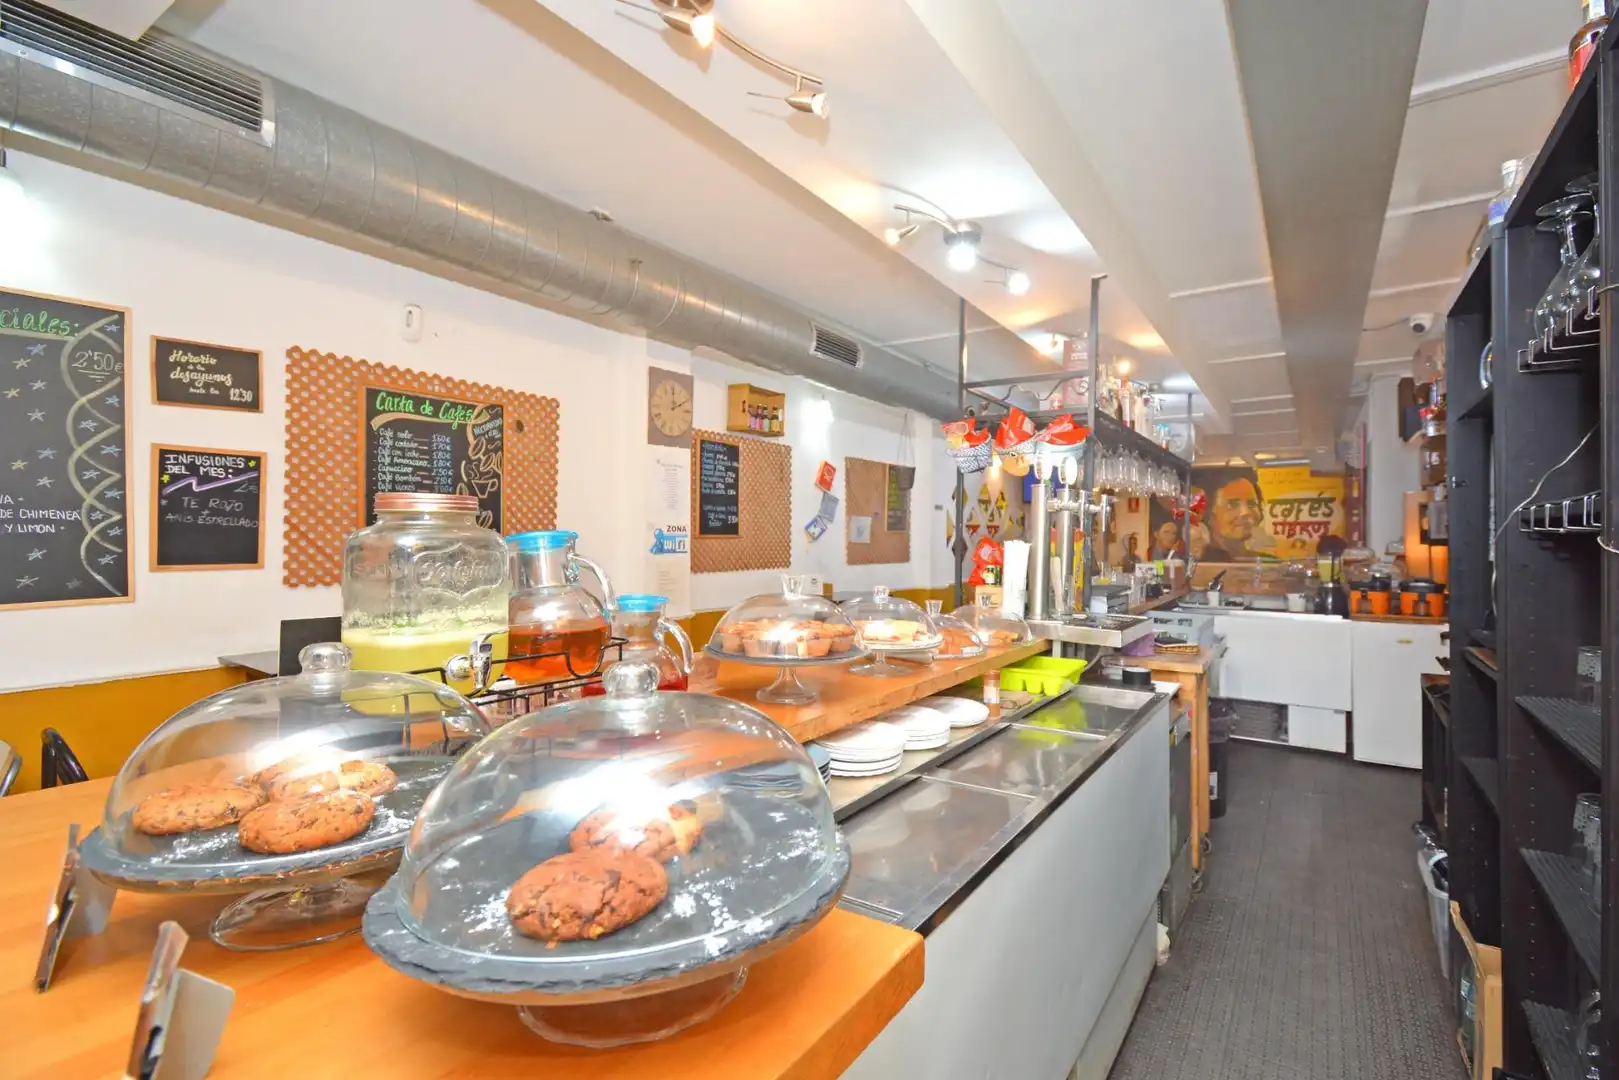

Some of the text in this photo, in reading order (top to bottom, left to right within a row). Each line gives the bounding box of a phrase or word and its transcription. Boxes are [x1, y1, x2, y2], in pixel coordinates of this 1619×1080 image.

[168, 349, 217, 365] Horario
[169, 366, 233, 387] desayunos
[375, 391, 415, 412] Carta
[419, 399, 434, 416] de
[438, 401, 474, 430] Cafés
[164, 453, 245, 468] INFUSIONES
[164, 465, 191, 475] DEL
[208, 498, 244, 512] ROJO
[19, 508, 82, 520] CHIMENEA
[197, 515, 259, 528] ESTRELLADO
[4, 524, 56, 534] Y LIMON
[666, 525, 688, 533] ZONA
